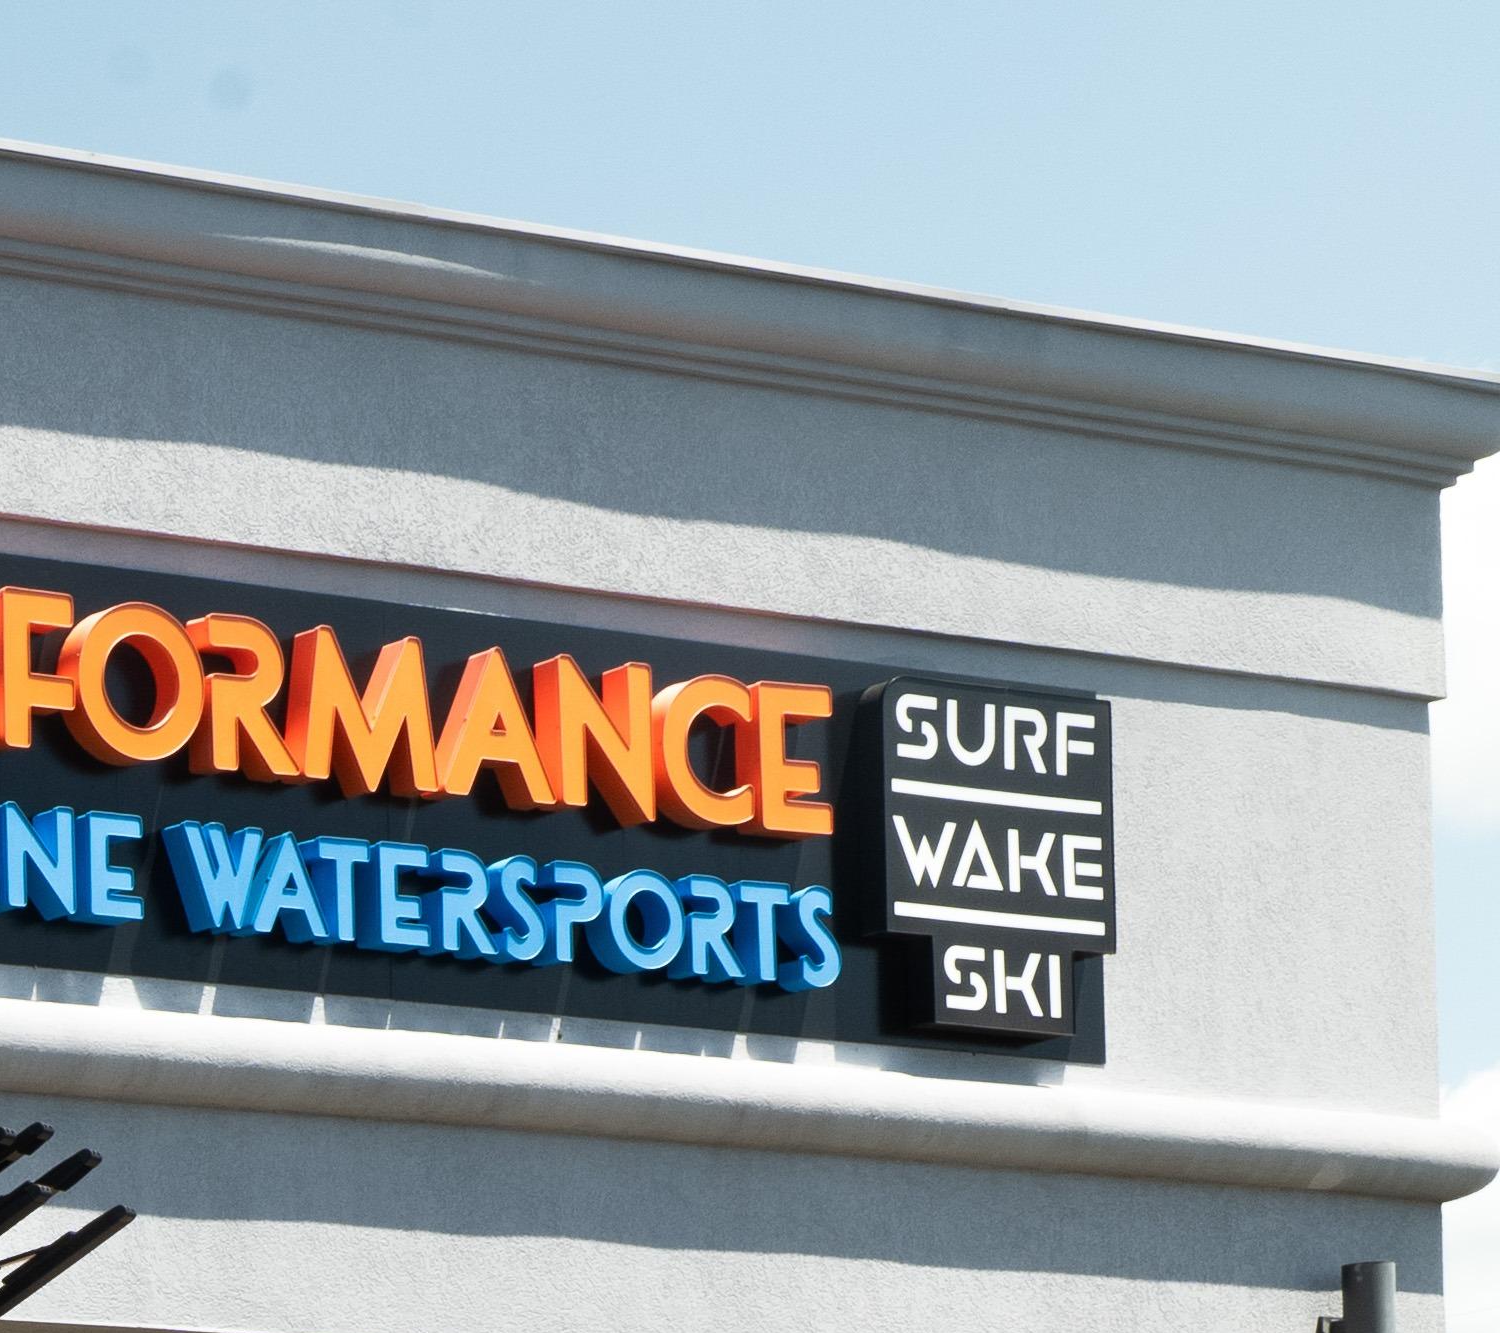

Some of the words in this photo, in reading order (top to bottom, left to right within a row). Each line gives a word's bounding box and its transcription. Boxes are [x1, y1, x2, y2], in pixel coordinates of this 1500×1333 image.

[895, 692, 1097, 776] SURF
[895, 815, 1104, 900] WAKE
[162, 820, 842, 993] WATERSPORTS
[943, 943, 1063, 1019] SKI
